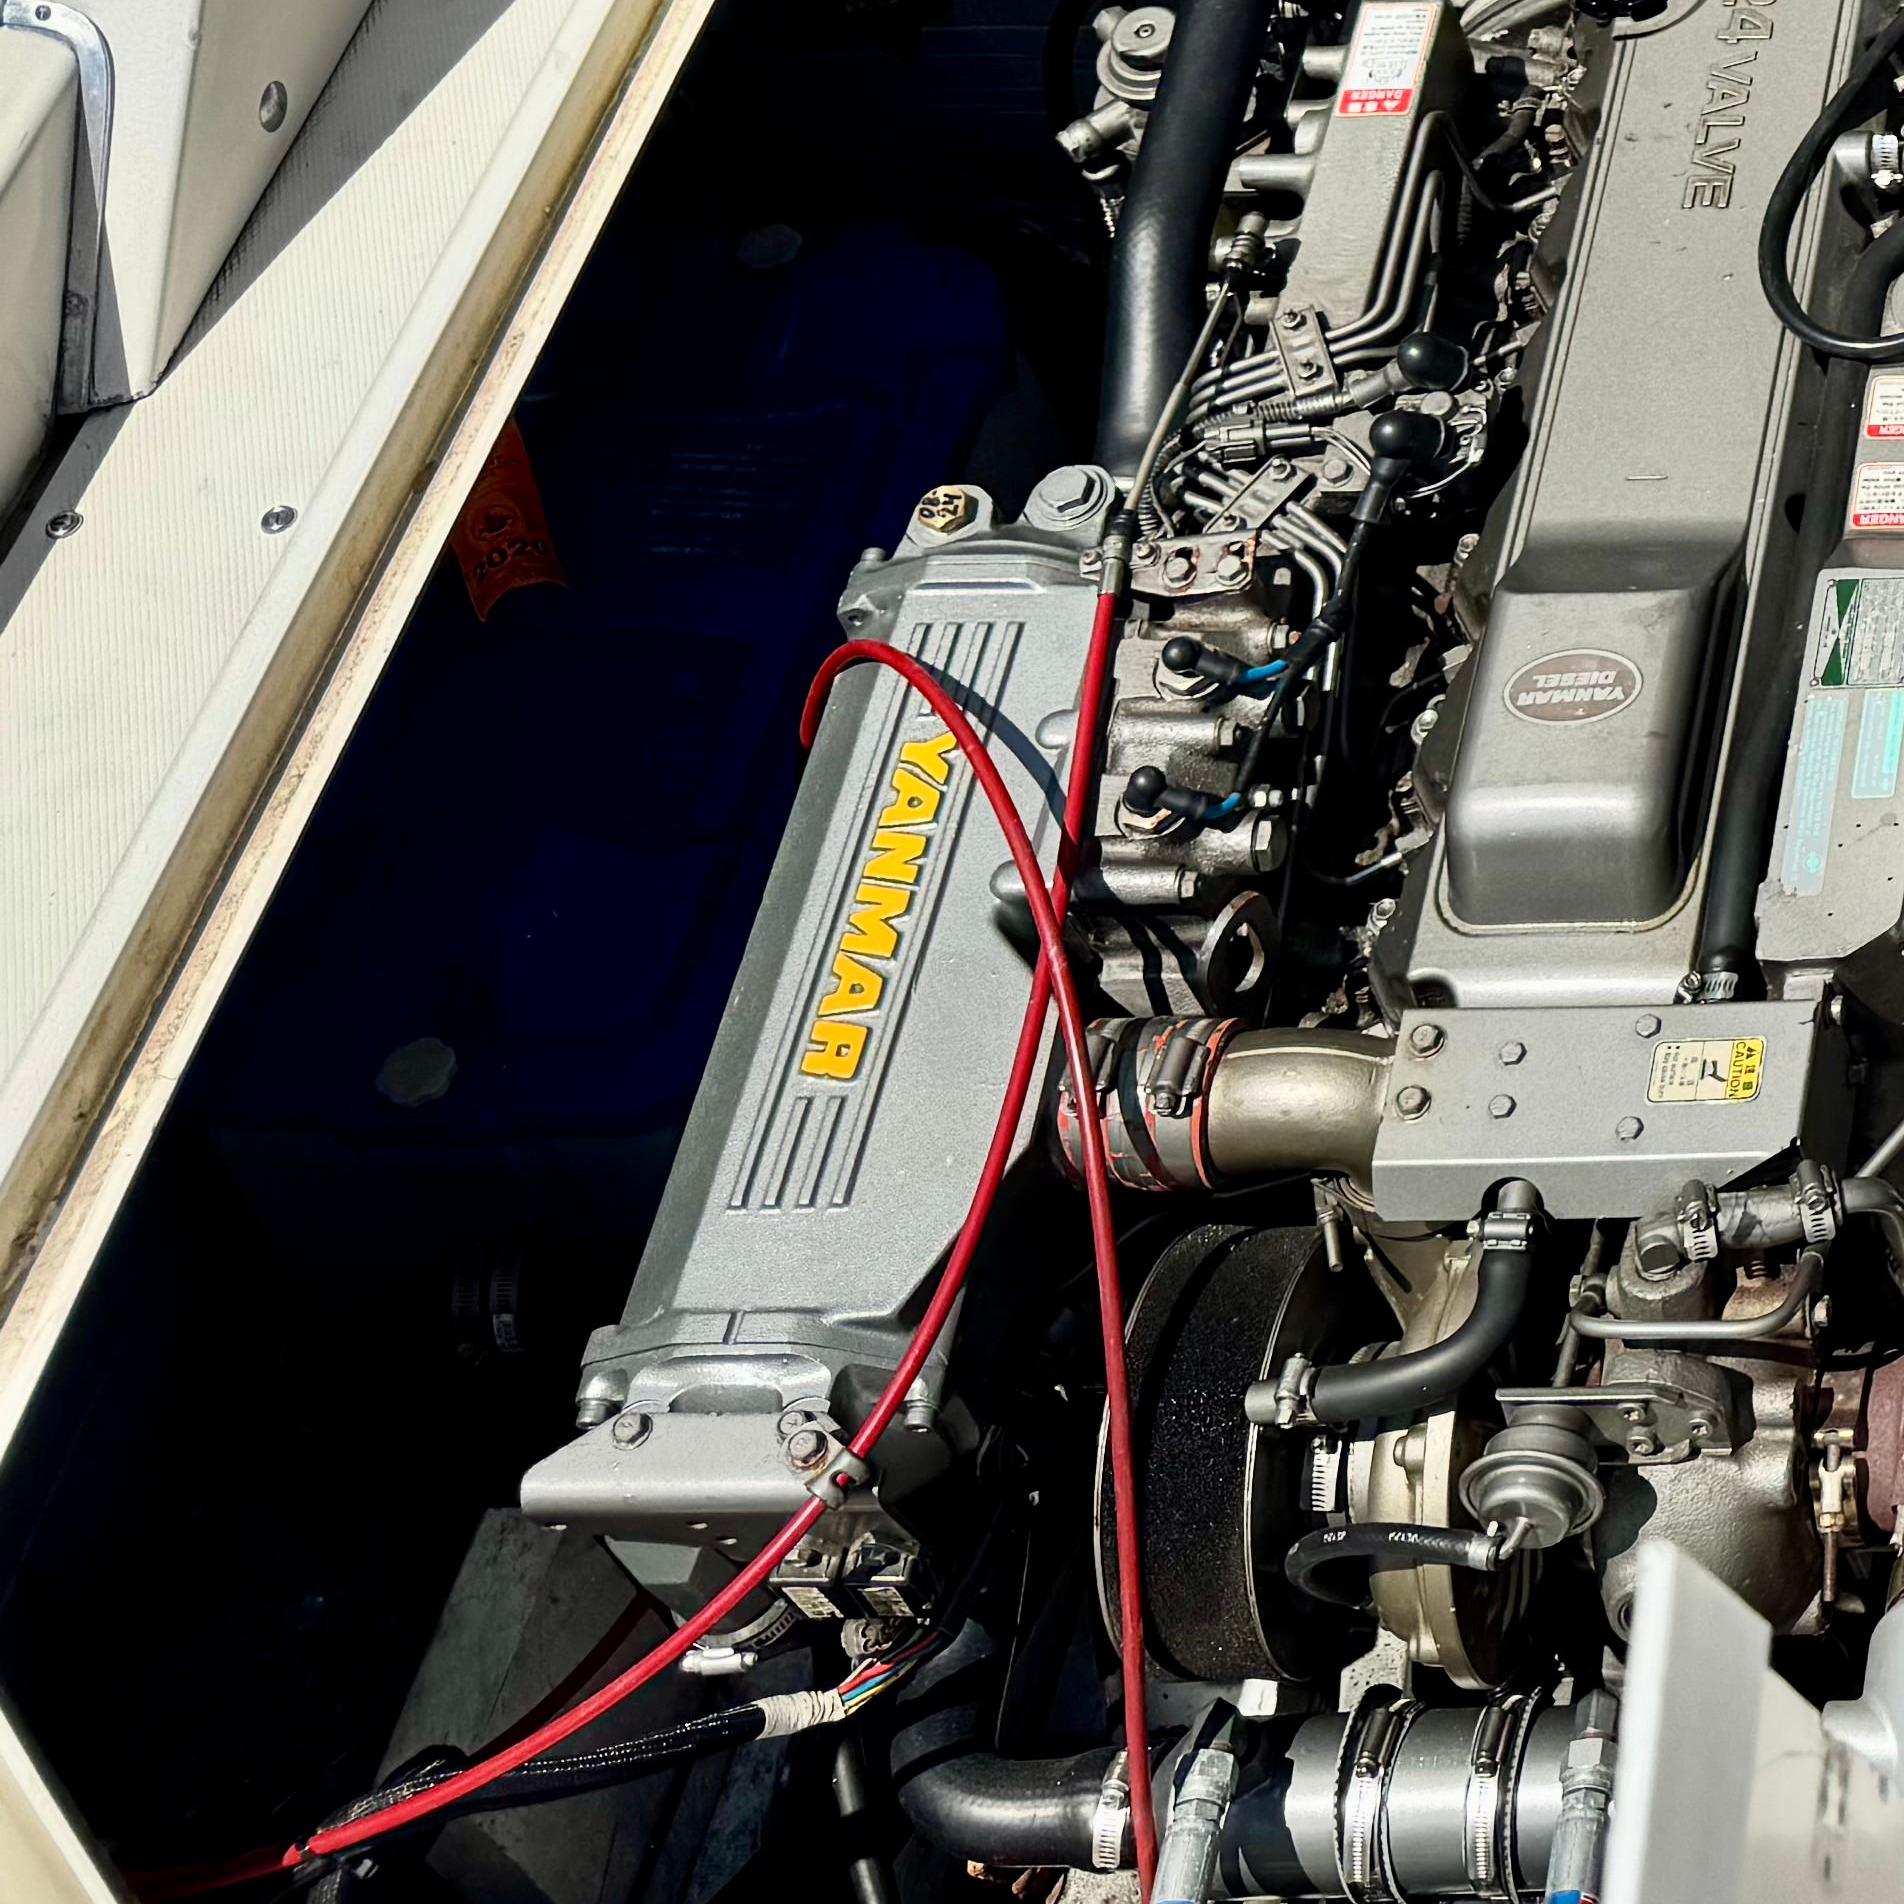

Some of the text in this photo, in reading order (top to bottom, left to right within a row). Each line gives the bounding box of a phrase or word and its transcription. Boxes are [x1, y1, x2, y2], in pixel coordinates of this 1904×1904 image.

[1683, 52, 1758, 211] VALVE
[1516, 686, 1626, 706] YANMAR
[1532, 670, 1618, 688] DIESEL
[799, 730, 963, 1083] YANMAR
[1728, 1041, 1747, 1098] CAUTION
